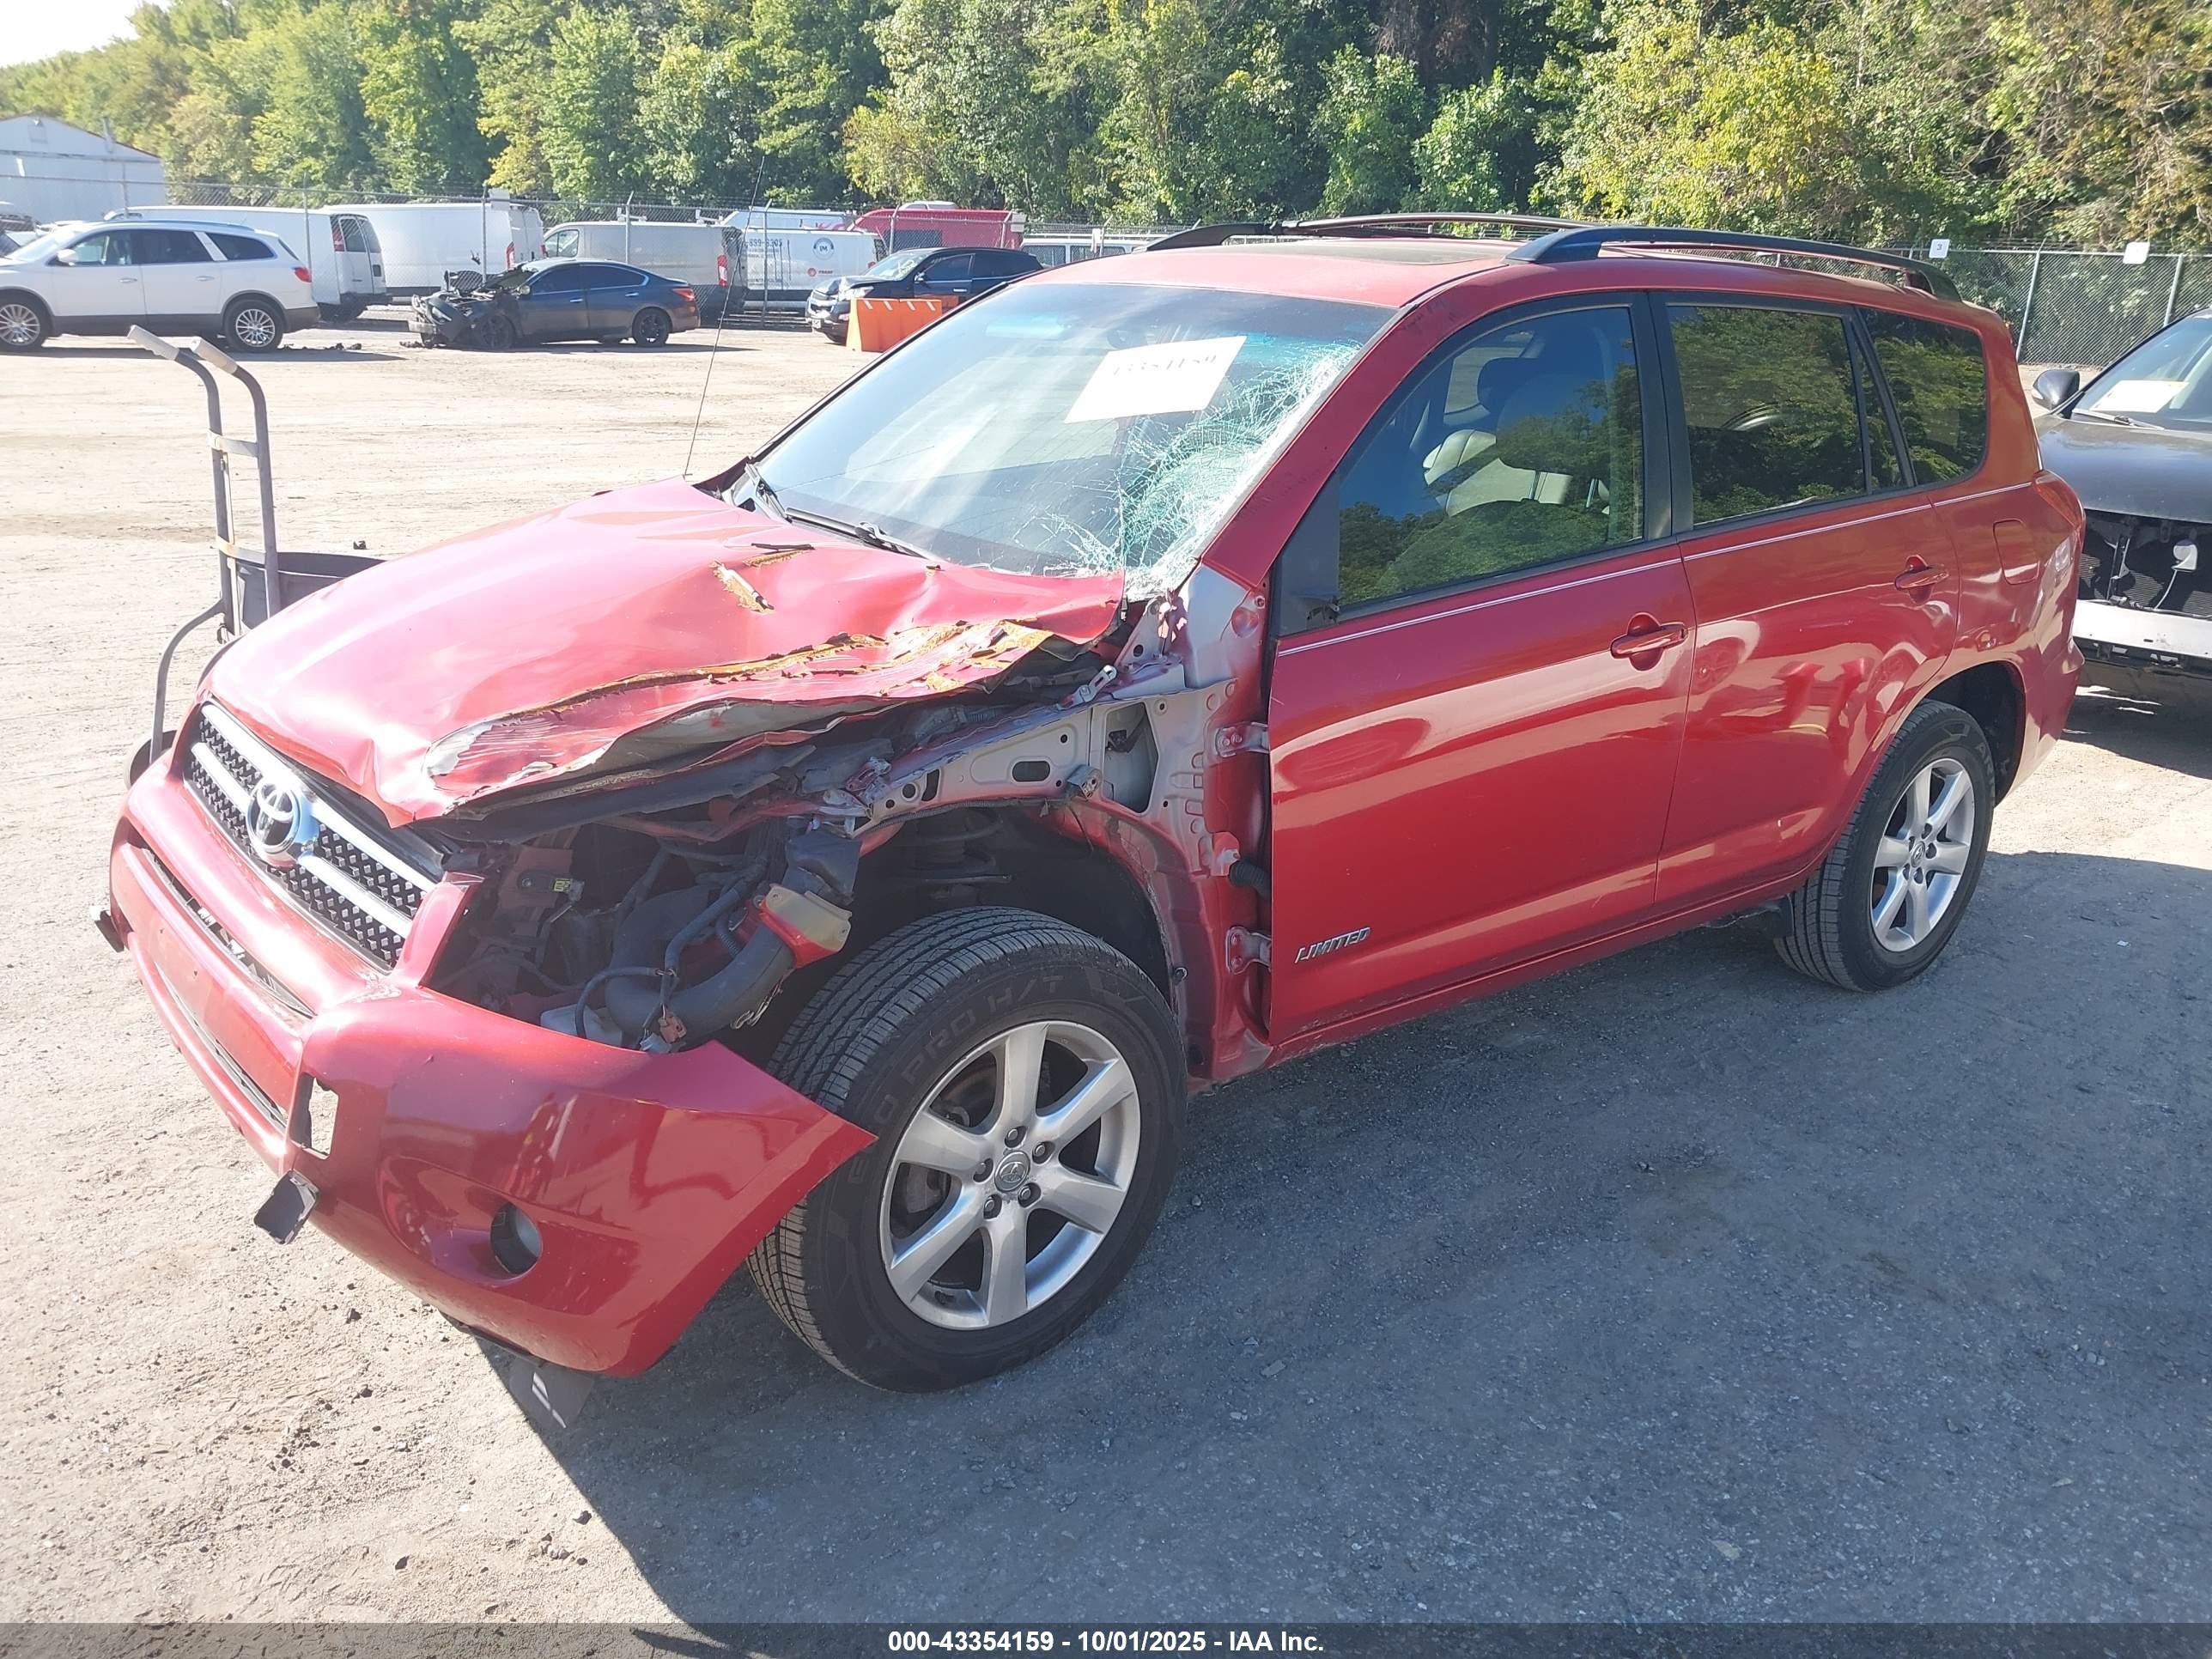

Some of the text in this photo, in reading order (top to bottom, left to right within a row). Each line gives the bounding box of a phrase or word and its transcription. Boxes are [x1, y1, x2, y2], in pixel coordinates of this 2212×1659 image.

[1294, 927, 1371, 963] LIMITED
[900, 1008, 976, 1085] PRO
[987, 974, 1065, 1013] H/T
